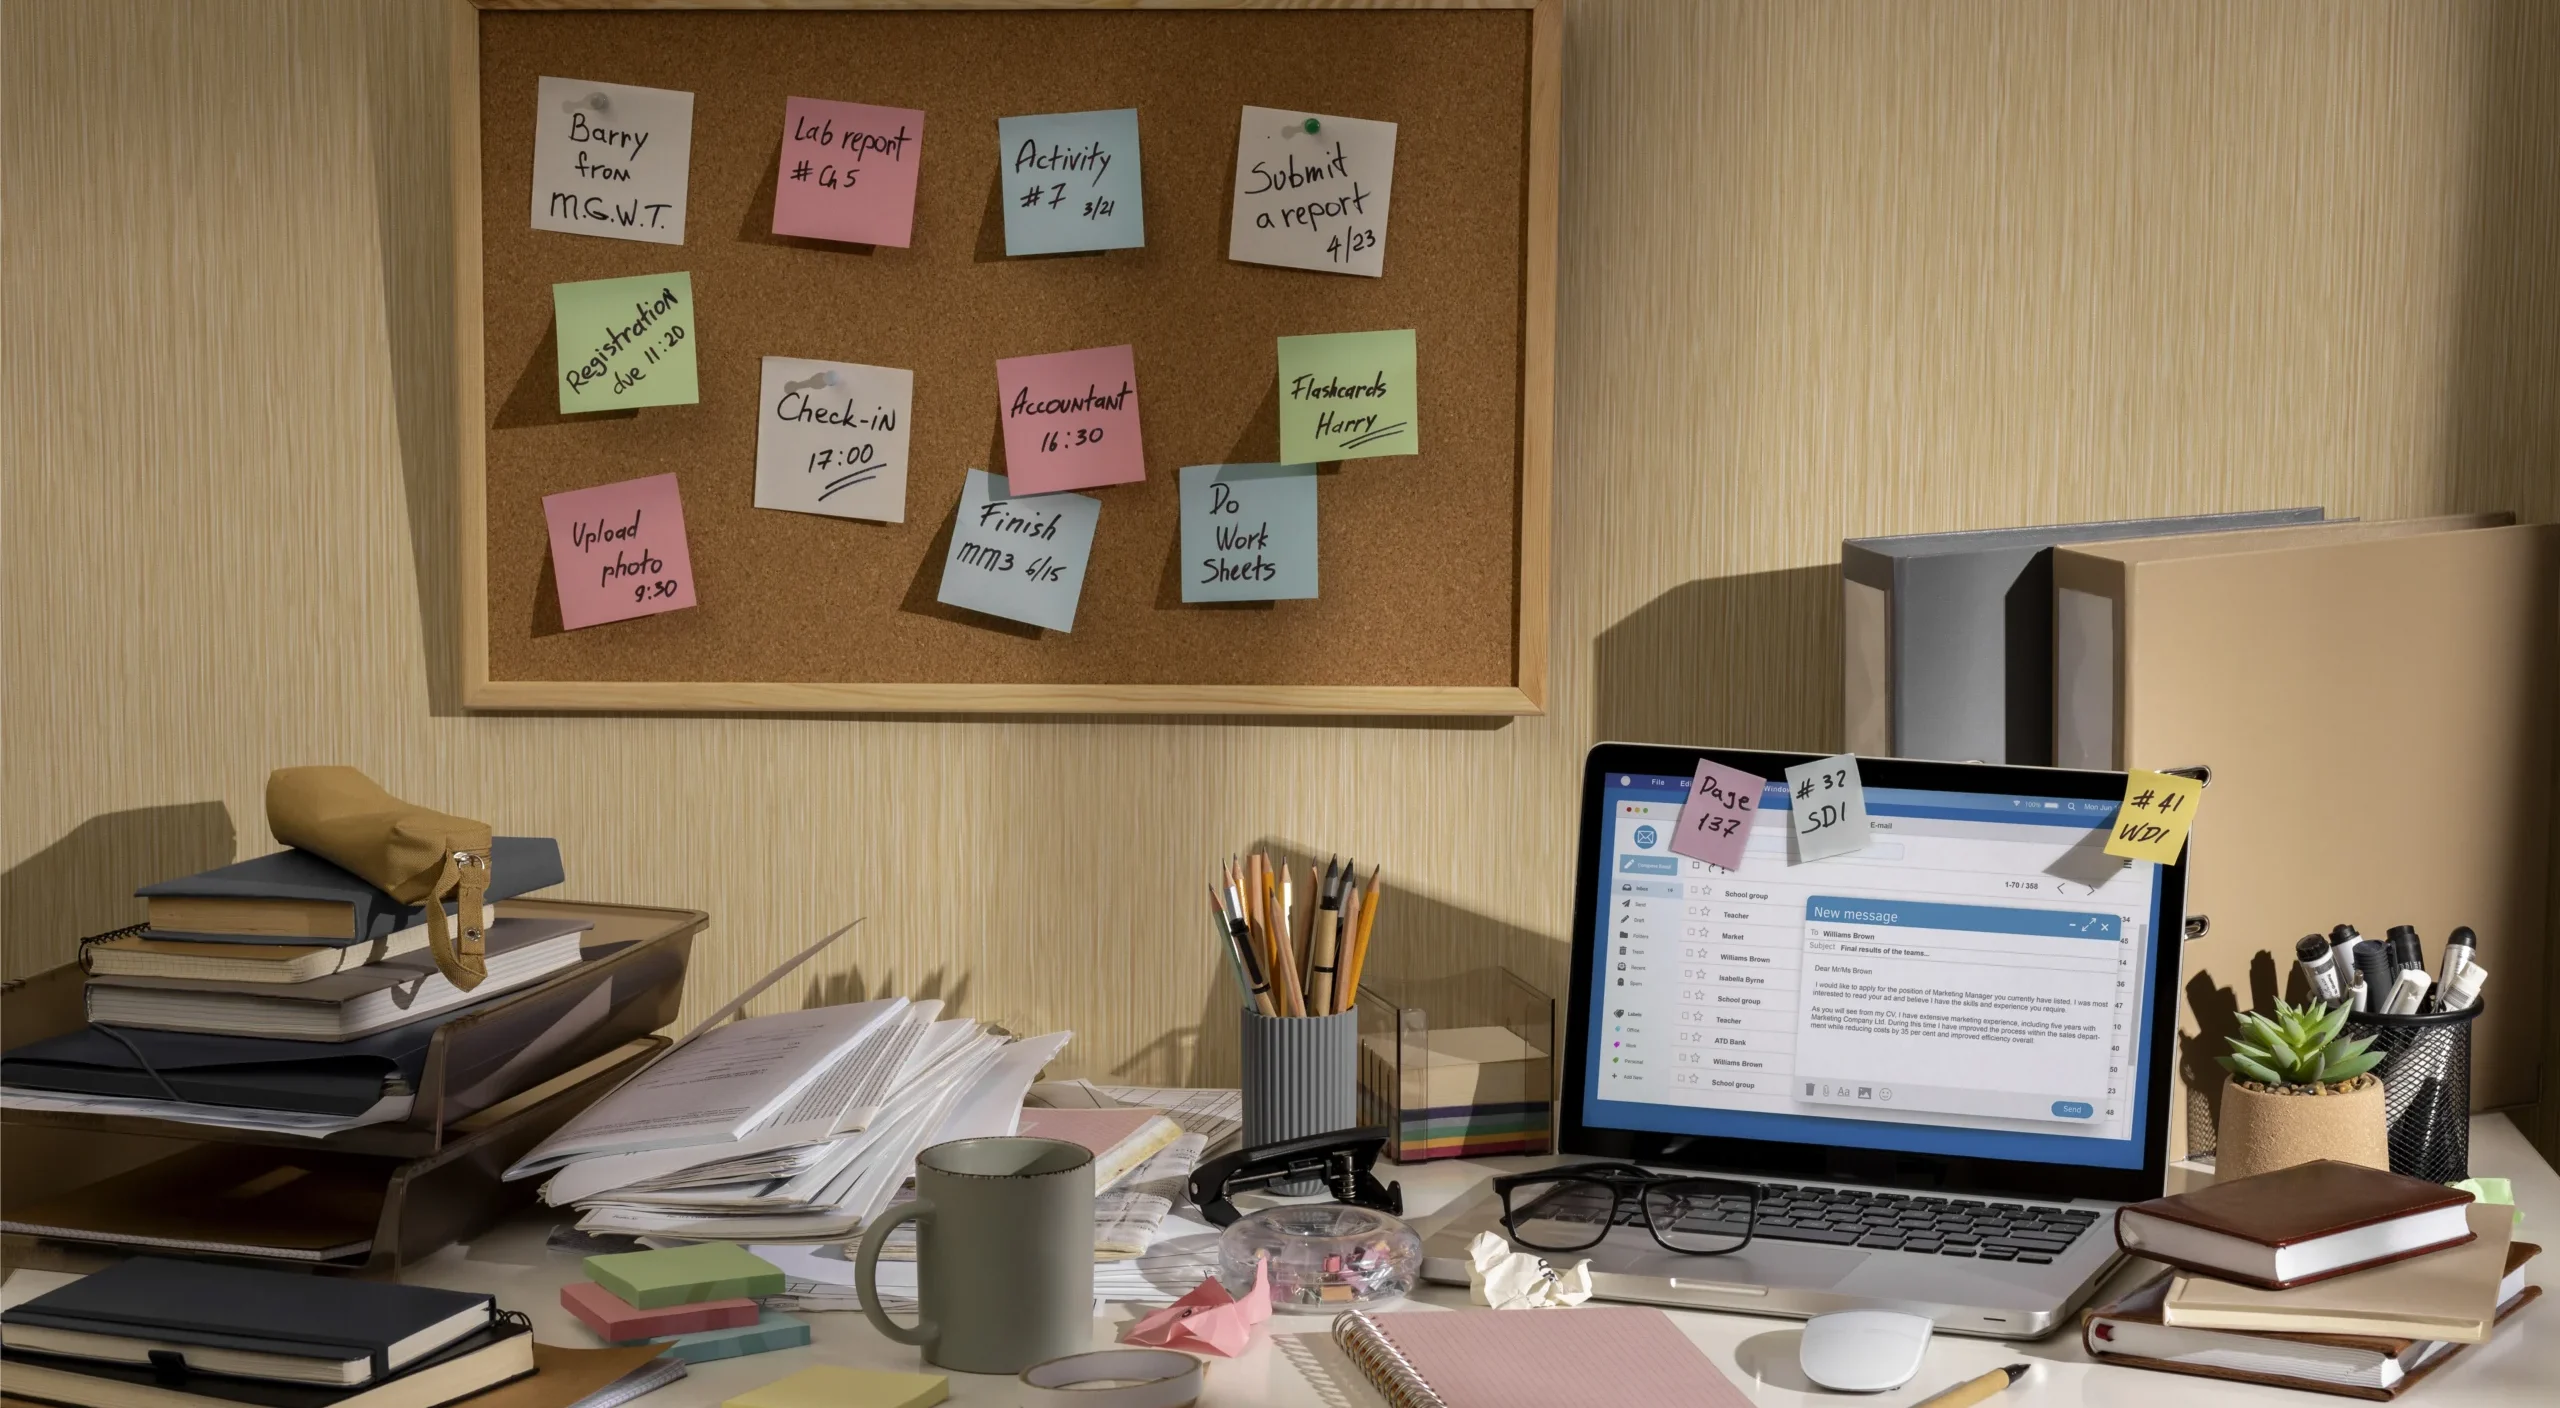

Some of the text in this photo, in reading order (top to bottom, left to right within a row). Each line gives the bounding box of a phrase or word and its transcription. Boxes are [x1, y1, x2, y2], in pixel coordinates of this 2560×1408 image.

[569, 113, 648, 161] Barry
[795, 116, 912, 162] Lab report
[575, 151, 630, 181] from
[790, 160, 812, 182] #
[844, 170, 860, 188] 5
[1015, 139, 1111, 187] Activity
[1245, 142, 1348, 194] Submit
[1083, 198, 1116, 221] 3/21
[1256, 182, 1372, 232] a report
[1327, 227, 1375, 263] 4/23
[614, 324, 686, 394] due 11:20
[1291, 371, 1386, 400] Flashcards
[1042, 428, 1103, 452] 16:30
[1315, 411, 1378, 440] Harry
[808, 444, 875, 474] 17:00
[1210, 483, 1239, 514] Do
[574, 509, 640, 553] Upload
[980, 502, 1062, 540] Finish
[1216, 522, 1268, 551] Work
[602, 549, 662, 588] photo
[1026, 556, 1066, 581] 6/15
[1201, 555, 1275, 584] Sheets
[635, 580, 677, 602] 9:30
[1700, 776, 1750, 811] Page
[1796, 778, 1814, 799] #
[1698, 813, 1740, 838] 137
[1814, 906, 1897, 924] New message
[1809, 941, 1835, 950] Subject
[1932, 989, 1963, 998] Marketing
[1964, 991, 1993, 1000] Manager
[1811, 1013, 1841, 1023] Marketing
[1843, 1015, 1873, 1025] Company
[1888, 1019, 1908, 1028] During
[1958, 1024, 1988, 1032] improved
[2047, 1029, 2057, 1037] the
[2059, 1030, 2076, 1038] sales
[1845, 1025, 1872, 1033] reducing
[1981, 1034, 2010, 1043] efficiency
[1950, 1016, 1981, 1025] marketing
[2021, 1020, 2049, 1029] including
